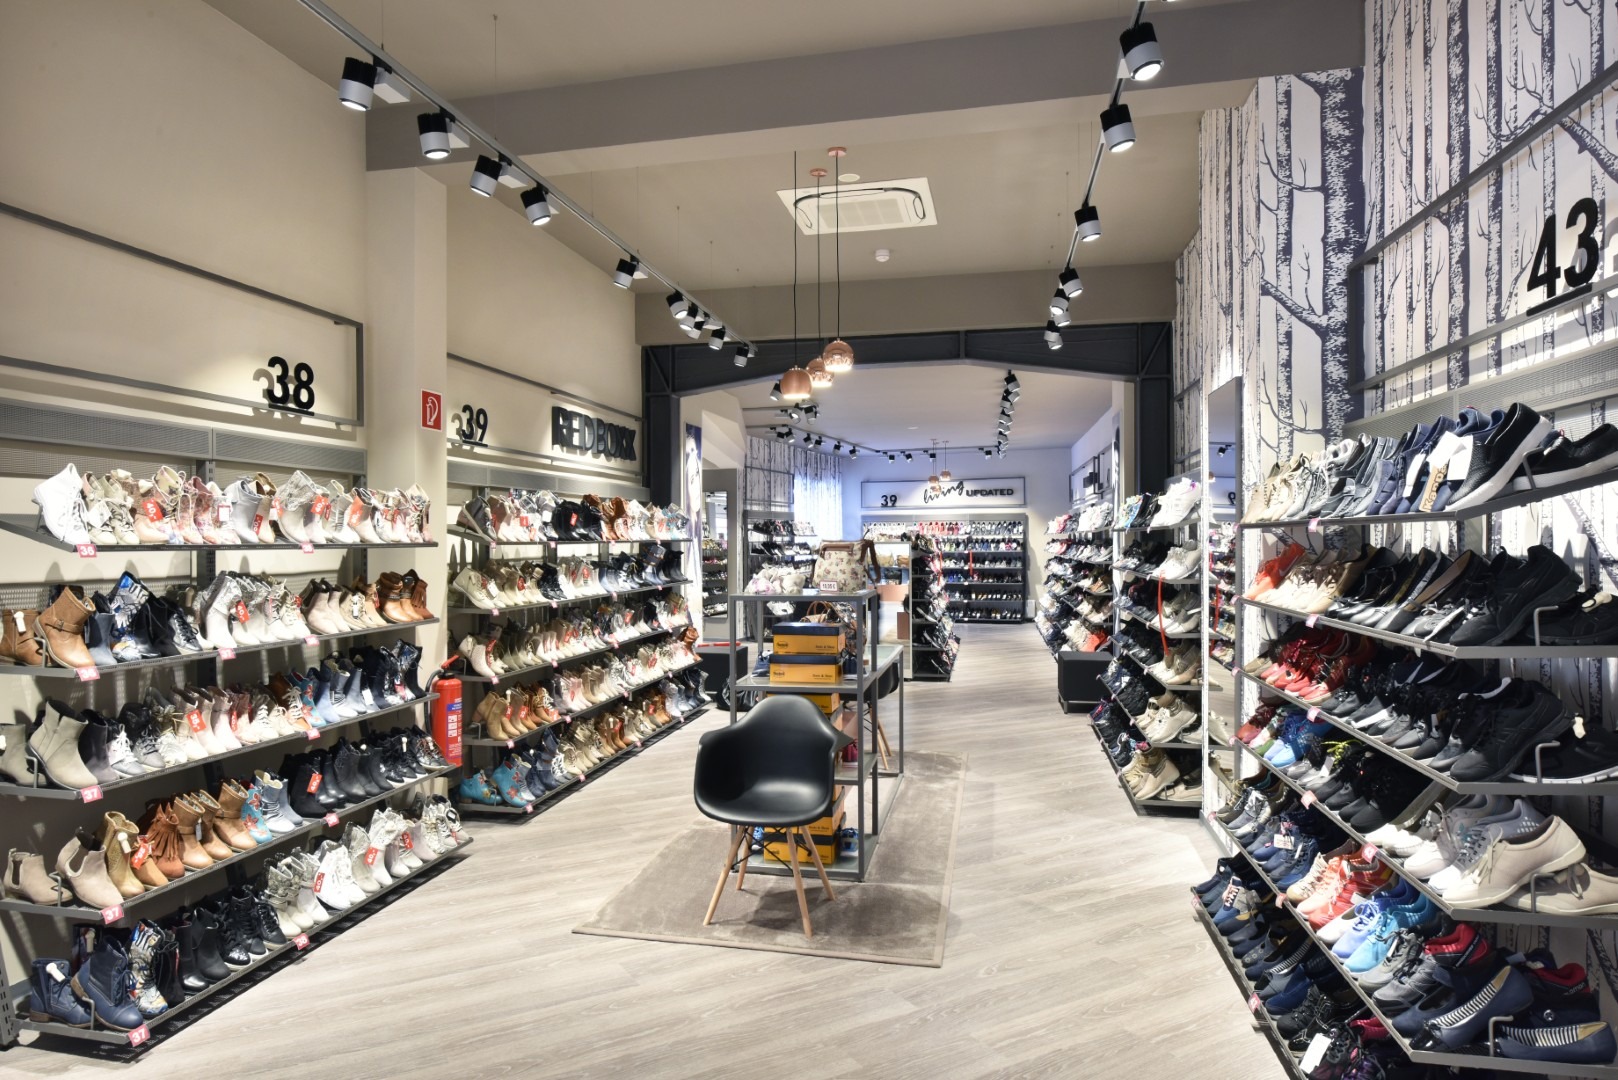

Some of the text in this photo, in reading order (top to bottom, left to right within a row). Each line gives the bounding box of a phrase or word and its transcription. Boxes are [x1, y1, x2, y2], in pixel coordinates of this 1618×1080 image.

[1527, 197, 1599, 299] 43
[267, 355, 315, 410] 38
[461, 404, 489, 443] 39
[966, 488, 1014, 497] UPDATED
[880, 494, 898, 507] 39
[80, 547, 94, 556] 36
[83, 788, 98, 800] 37
[105, 907, 120, 920] 37
[296, 935, 308, 947] 38
[132, 1028, 146, 1043] 37
